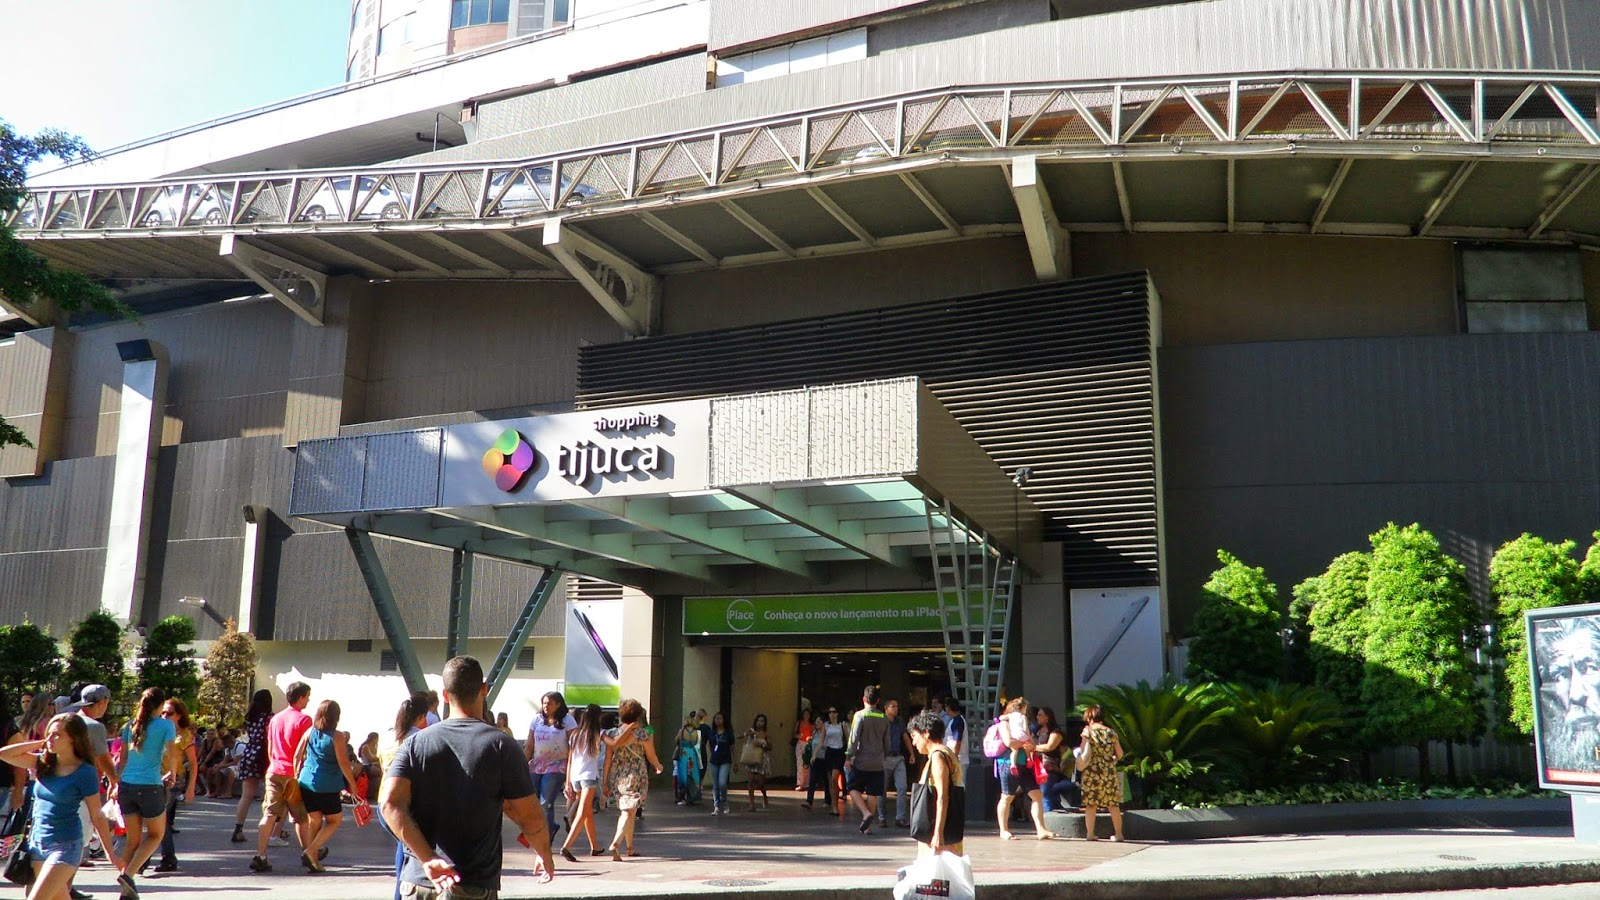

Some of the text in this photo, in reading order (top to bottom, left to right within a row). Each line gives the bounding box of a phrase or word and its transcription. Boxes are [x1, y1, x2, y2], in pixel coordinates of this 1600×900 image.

[593, 412, 660, 431] shopping
[553, 440, 659, 486] tijuca
[727, 610, 755, 620] iPlace
[763, 606, 950, 622] Conheça o novo lançamento na iPlac.
